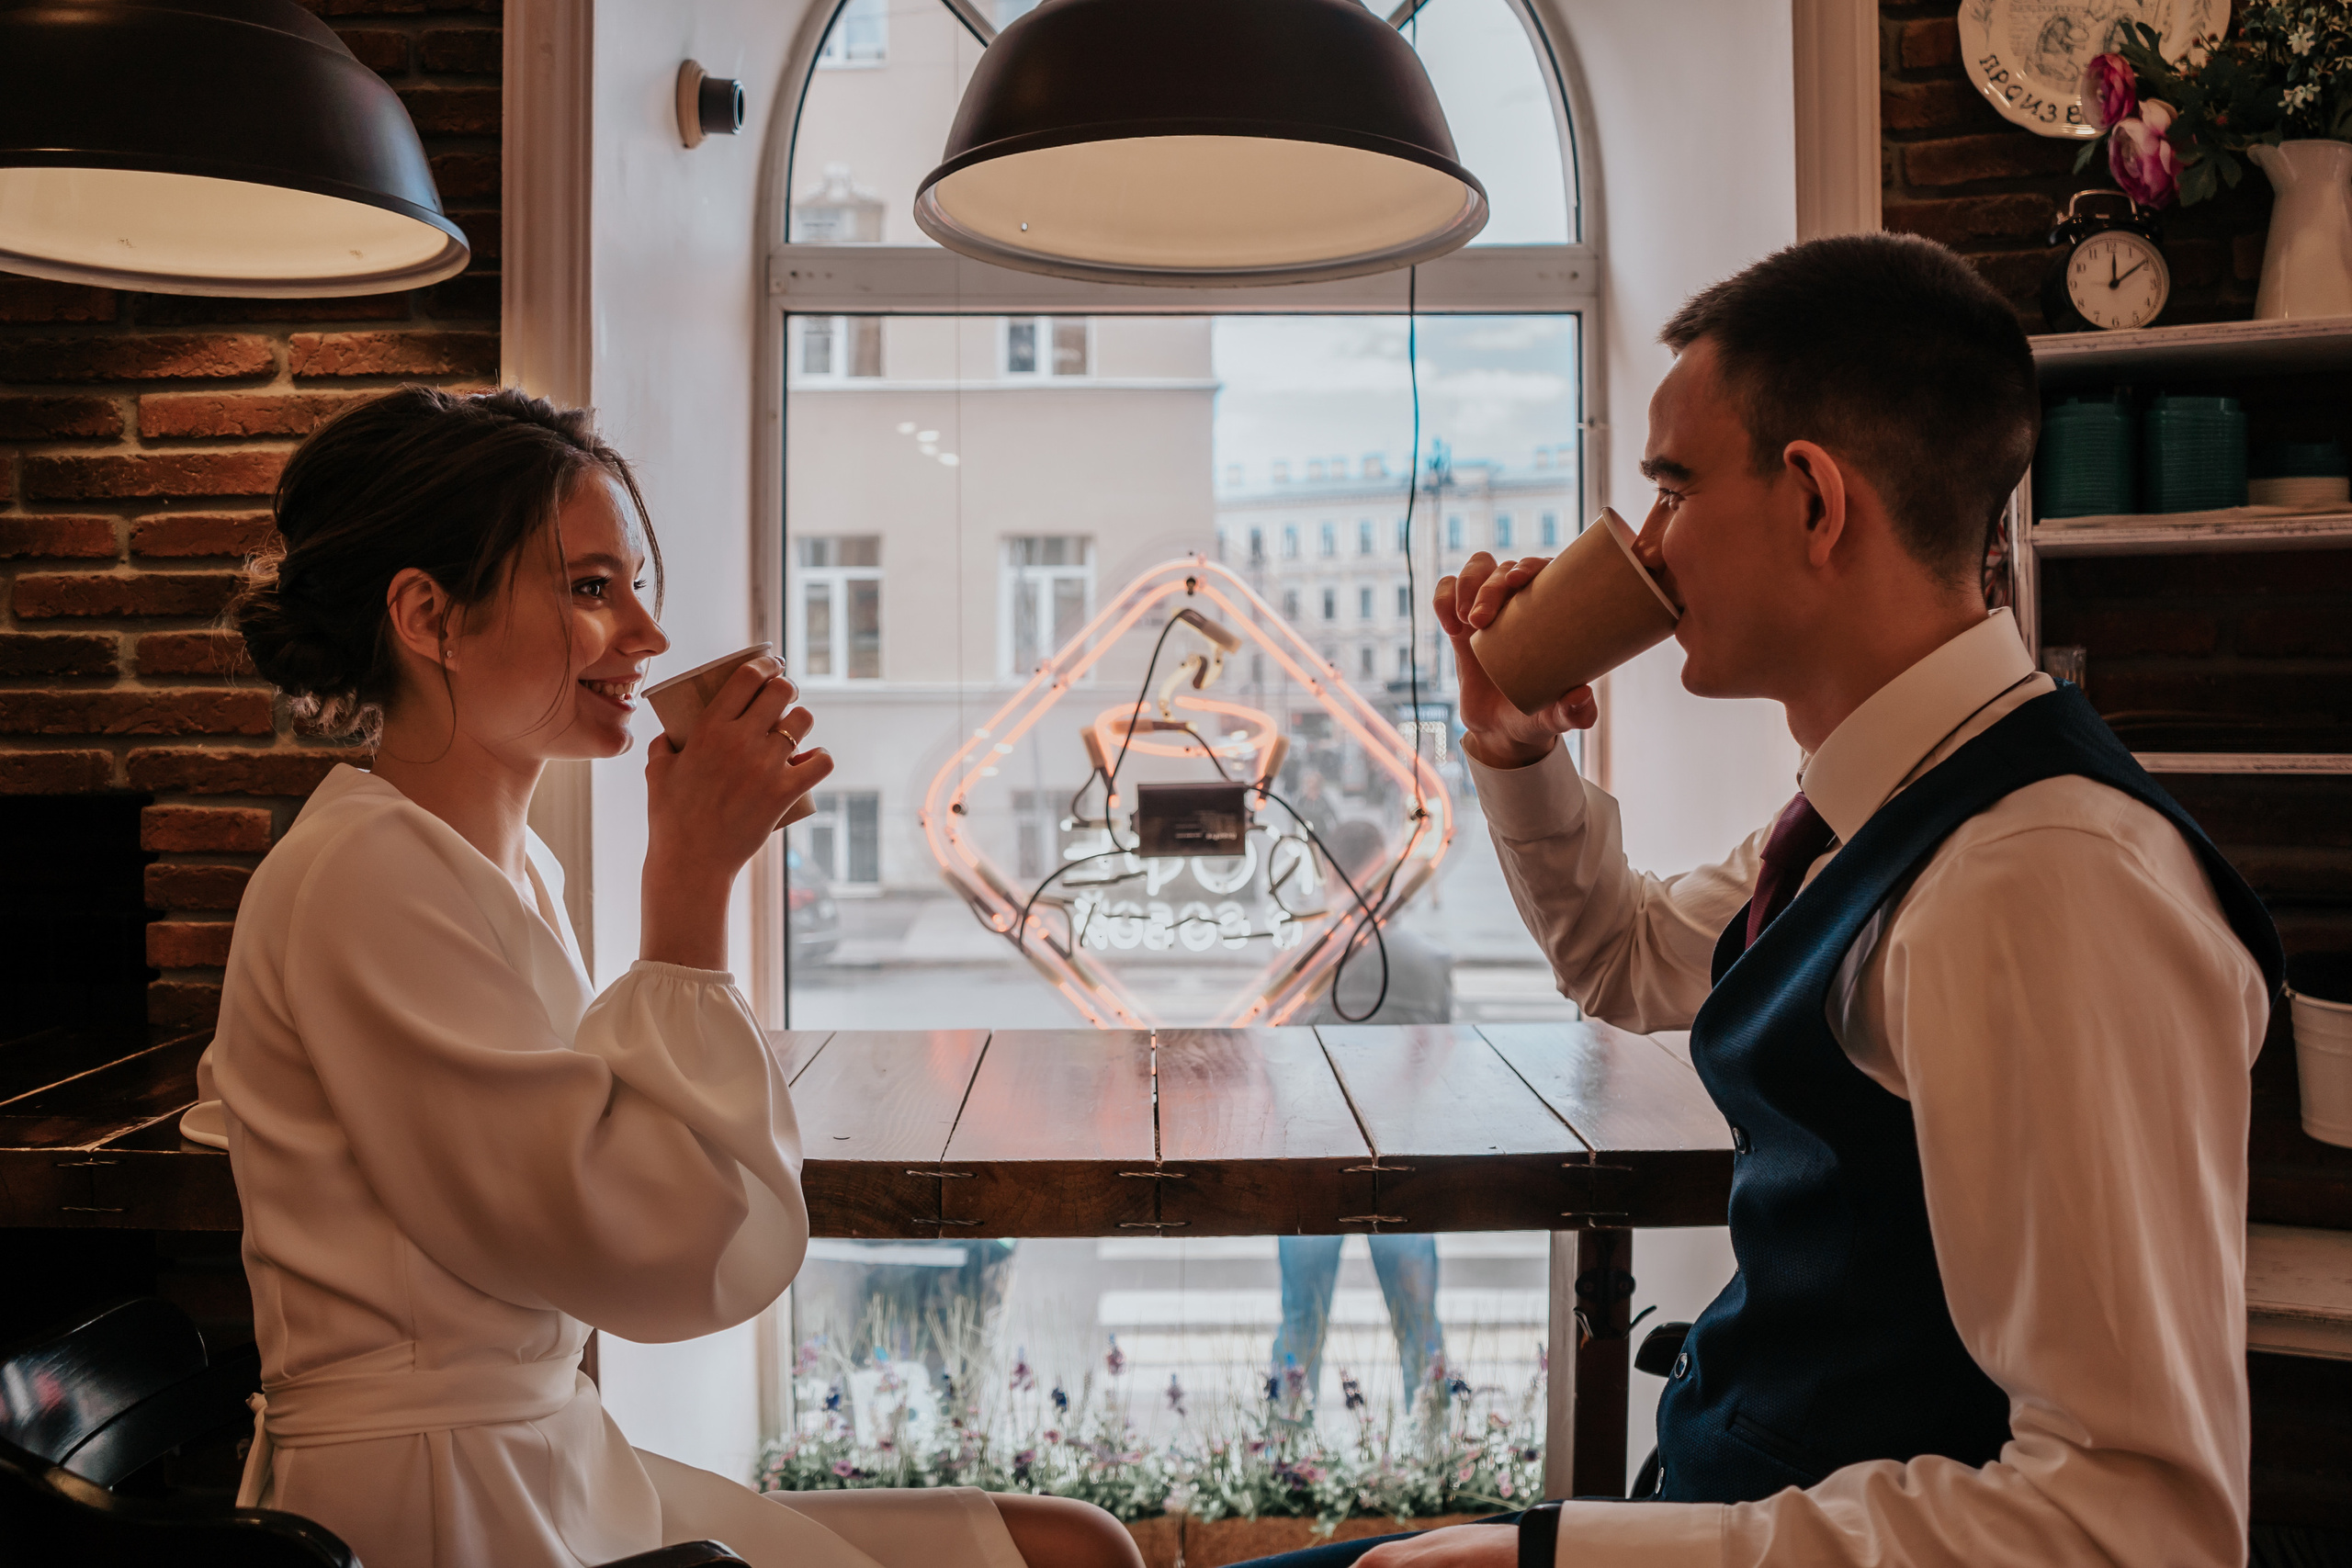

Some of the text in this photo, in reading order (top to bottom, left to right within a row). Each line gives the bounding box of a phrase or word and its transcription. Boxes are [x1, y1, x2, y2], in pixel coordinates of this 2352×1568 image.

[2088, 247, 2098, 260] 11
[2106, 242, 2117, 254] 12
[2076, 263, 2086, 274] 10
[2070, 278, 2077, 291] 9
[2077, 299, 2085, 310] 8
[2144, 297, 2151, 309] 4
[2094, 310, 2100, 322] 7
[2132, 310, 2140, 323] 5
[2111, 316, 2120, 329] 6
